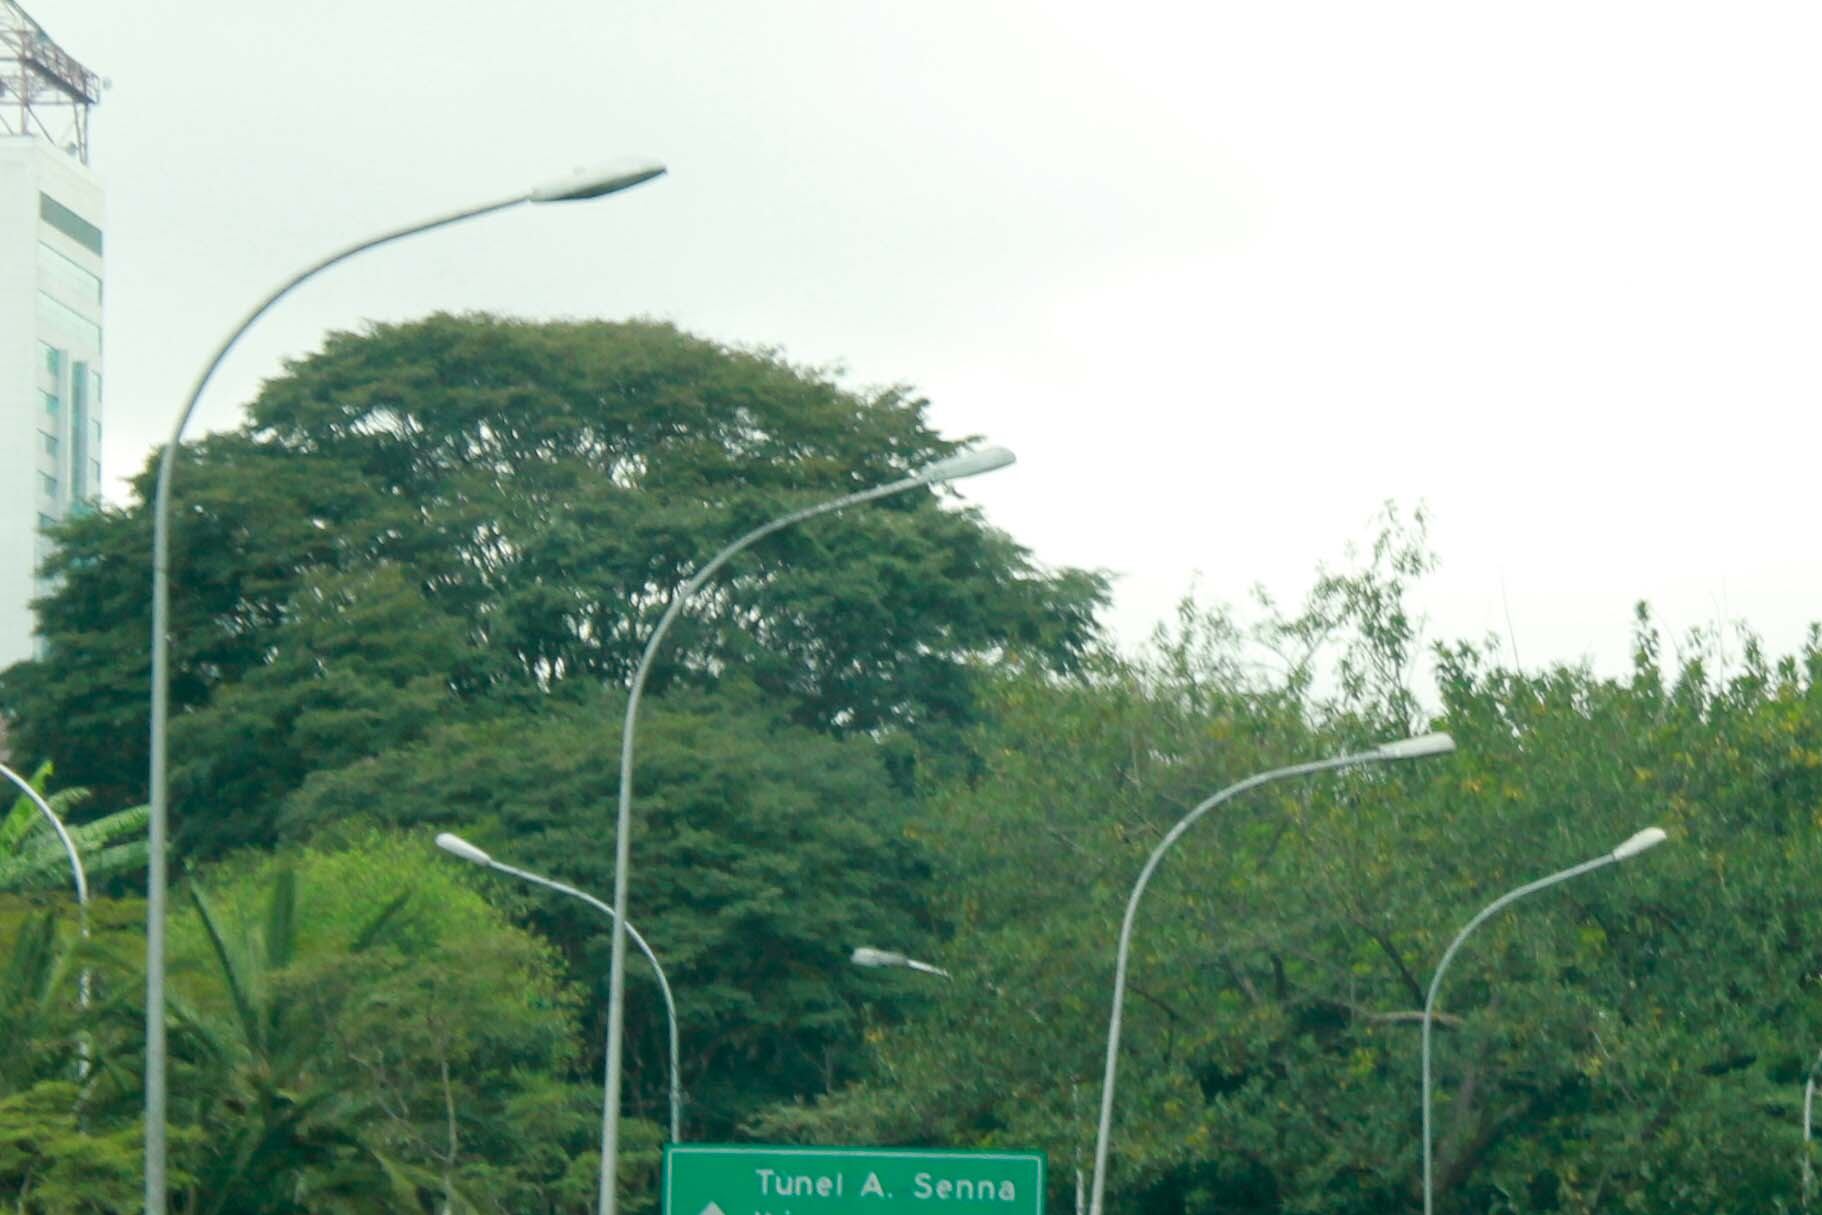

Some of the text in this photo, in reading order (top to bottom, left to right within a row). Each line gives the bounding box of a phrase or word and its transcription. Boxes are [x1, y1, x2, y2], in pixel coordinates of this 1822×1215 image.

[755, 1169, 1016, 1201] Tunel A. Senna
